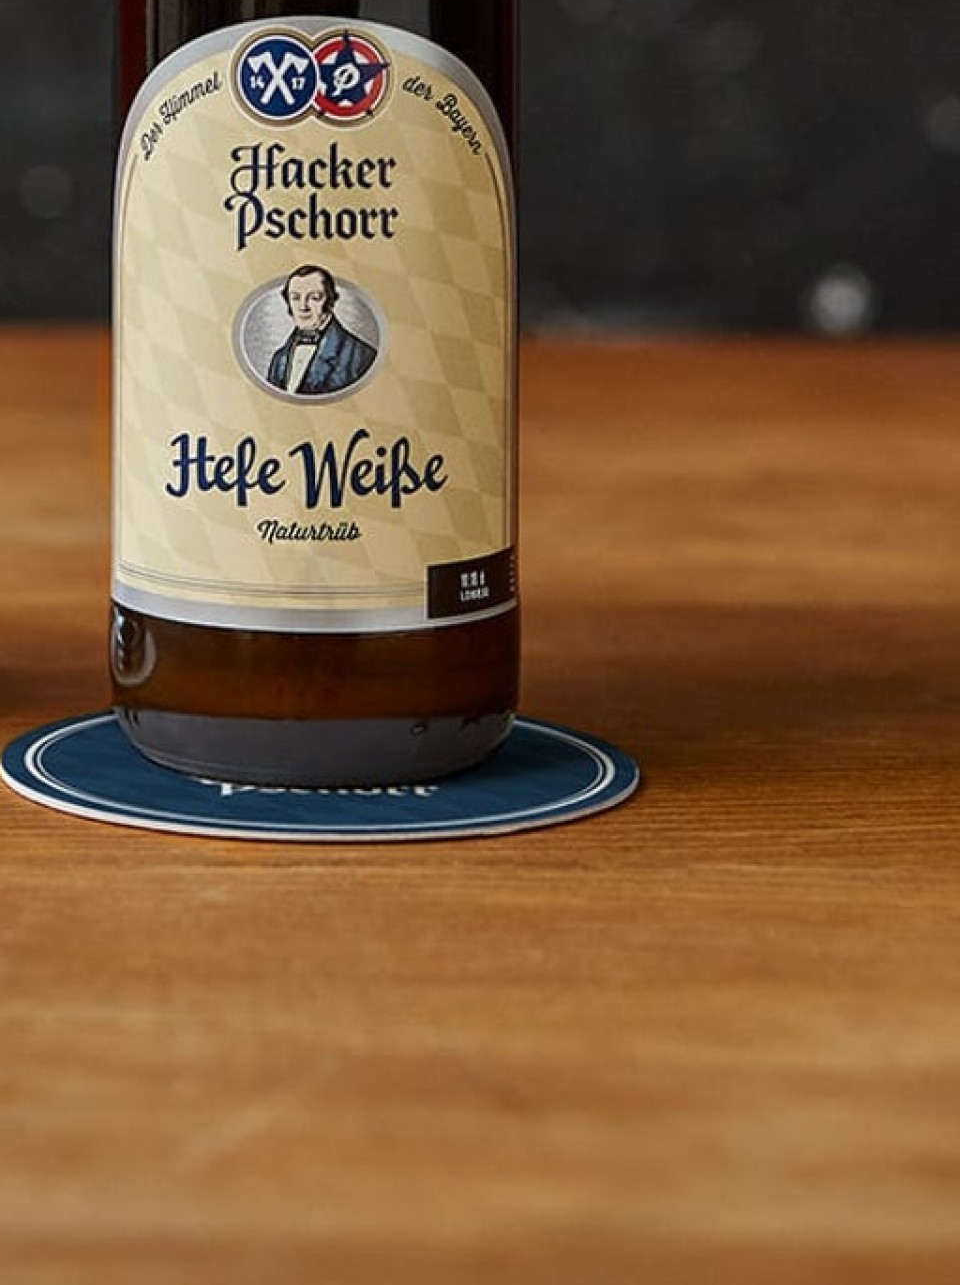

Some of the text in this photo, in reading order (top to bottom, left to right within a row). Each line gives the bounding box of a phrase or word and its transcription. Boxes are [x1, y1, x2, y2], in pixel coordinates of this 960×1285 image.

[141, 70, 223, 161] Der Himmel
[402, 76, 482, 155] der Bayern
[230, 142, 396, 195] Hacker
[225, 192, 398, 250] Pschorr
[165, 428, 448, 508] Hefe Weiße
[257, 520, 362, 544] Naturtrüb
